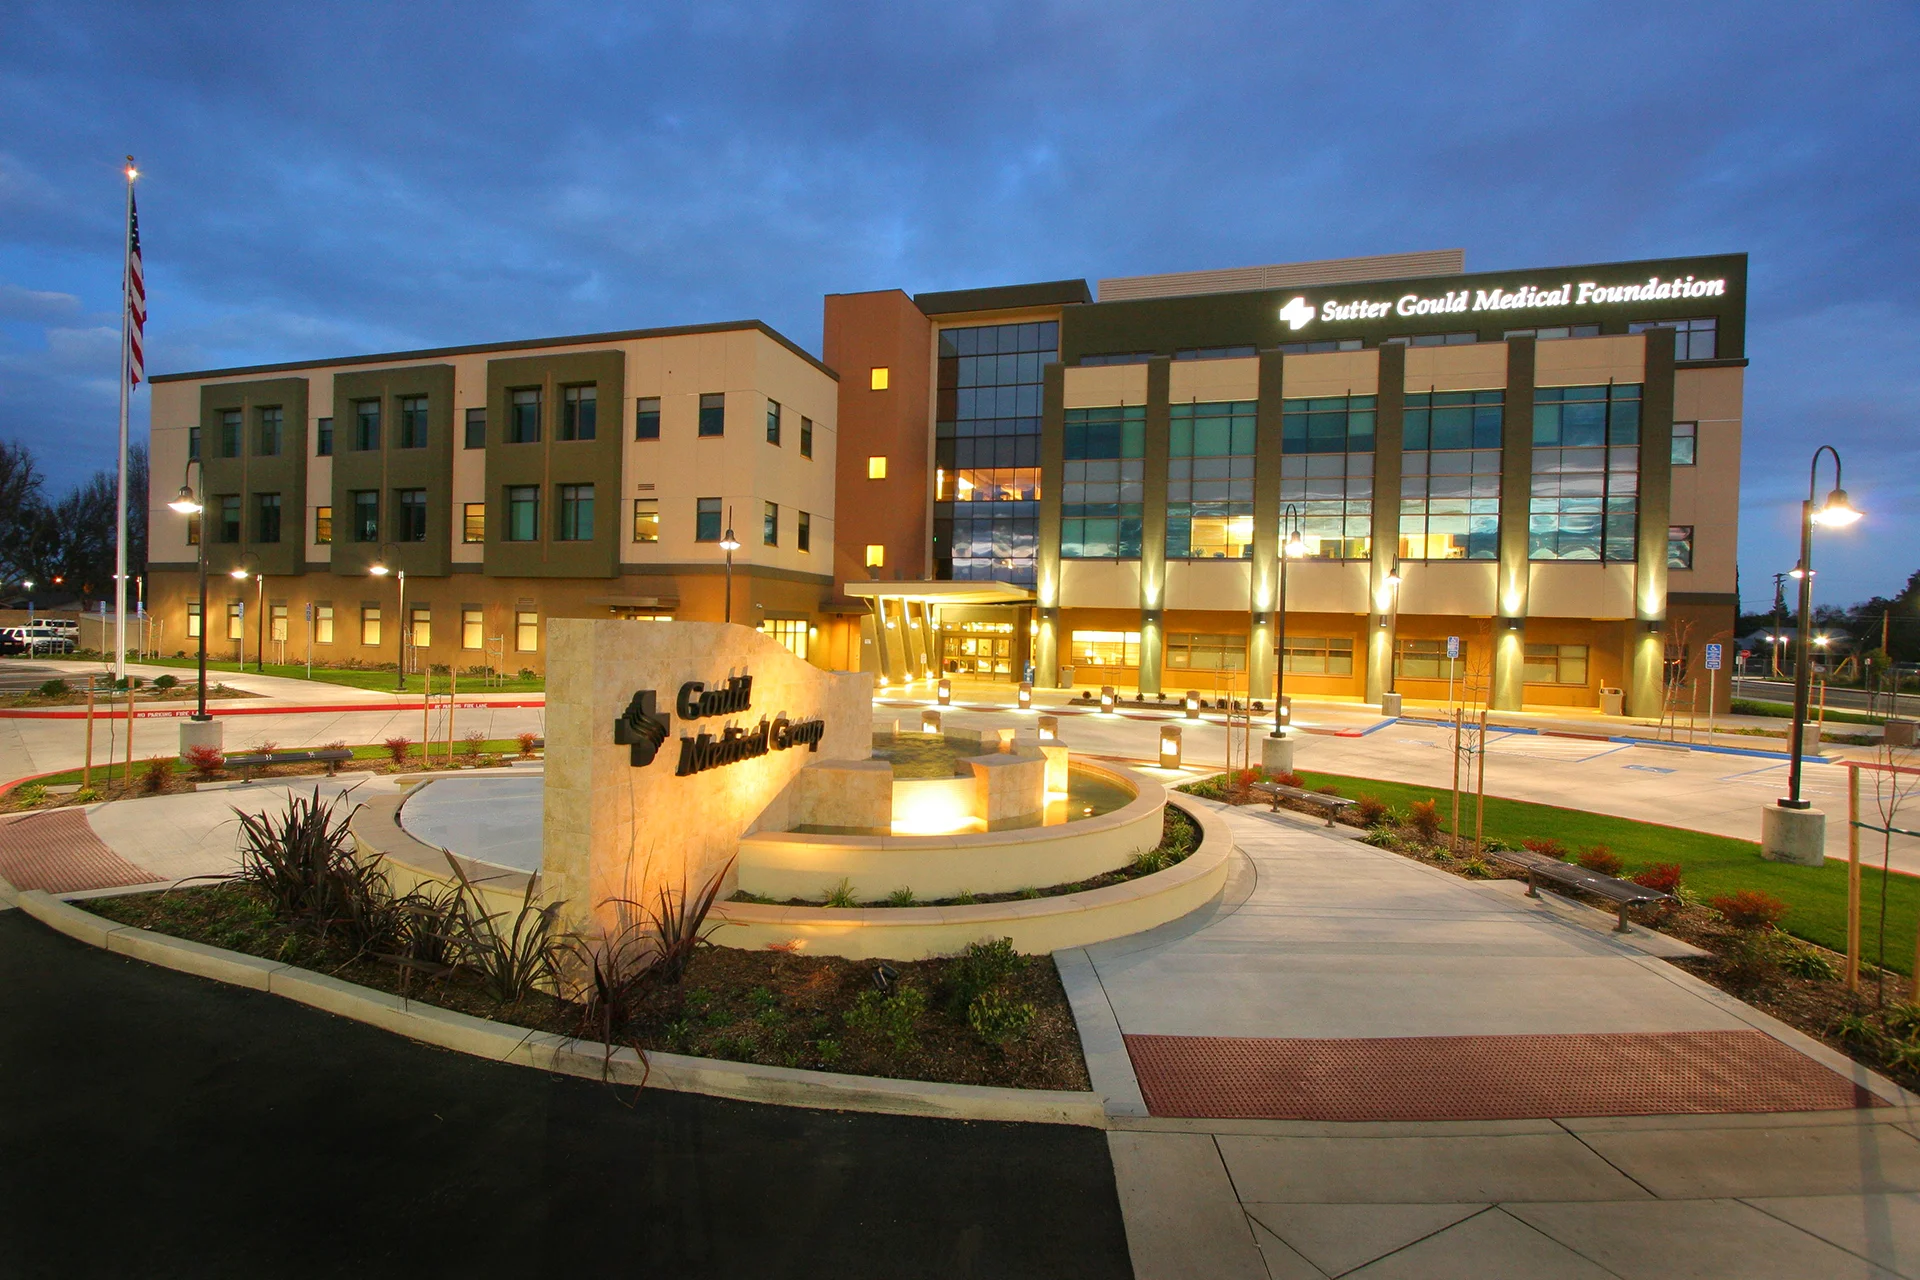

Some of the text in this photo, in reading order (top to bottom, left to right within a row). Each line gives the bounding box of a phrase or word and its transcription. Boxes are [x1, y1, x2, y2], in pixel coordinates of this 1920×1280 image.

[1321, 275, 1726, 322] Sutter Gould Medical Foundation
[676, 675, 753, 720] Gould
[675, 718, 825, 776] Medical Group
